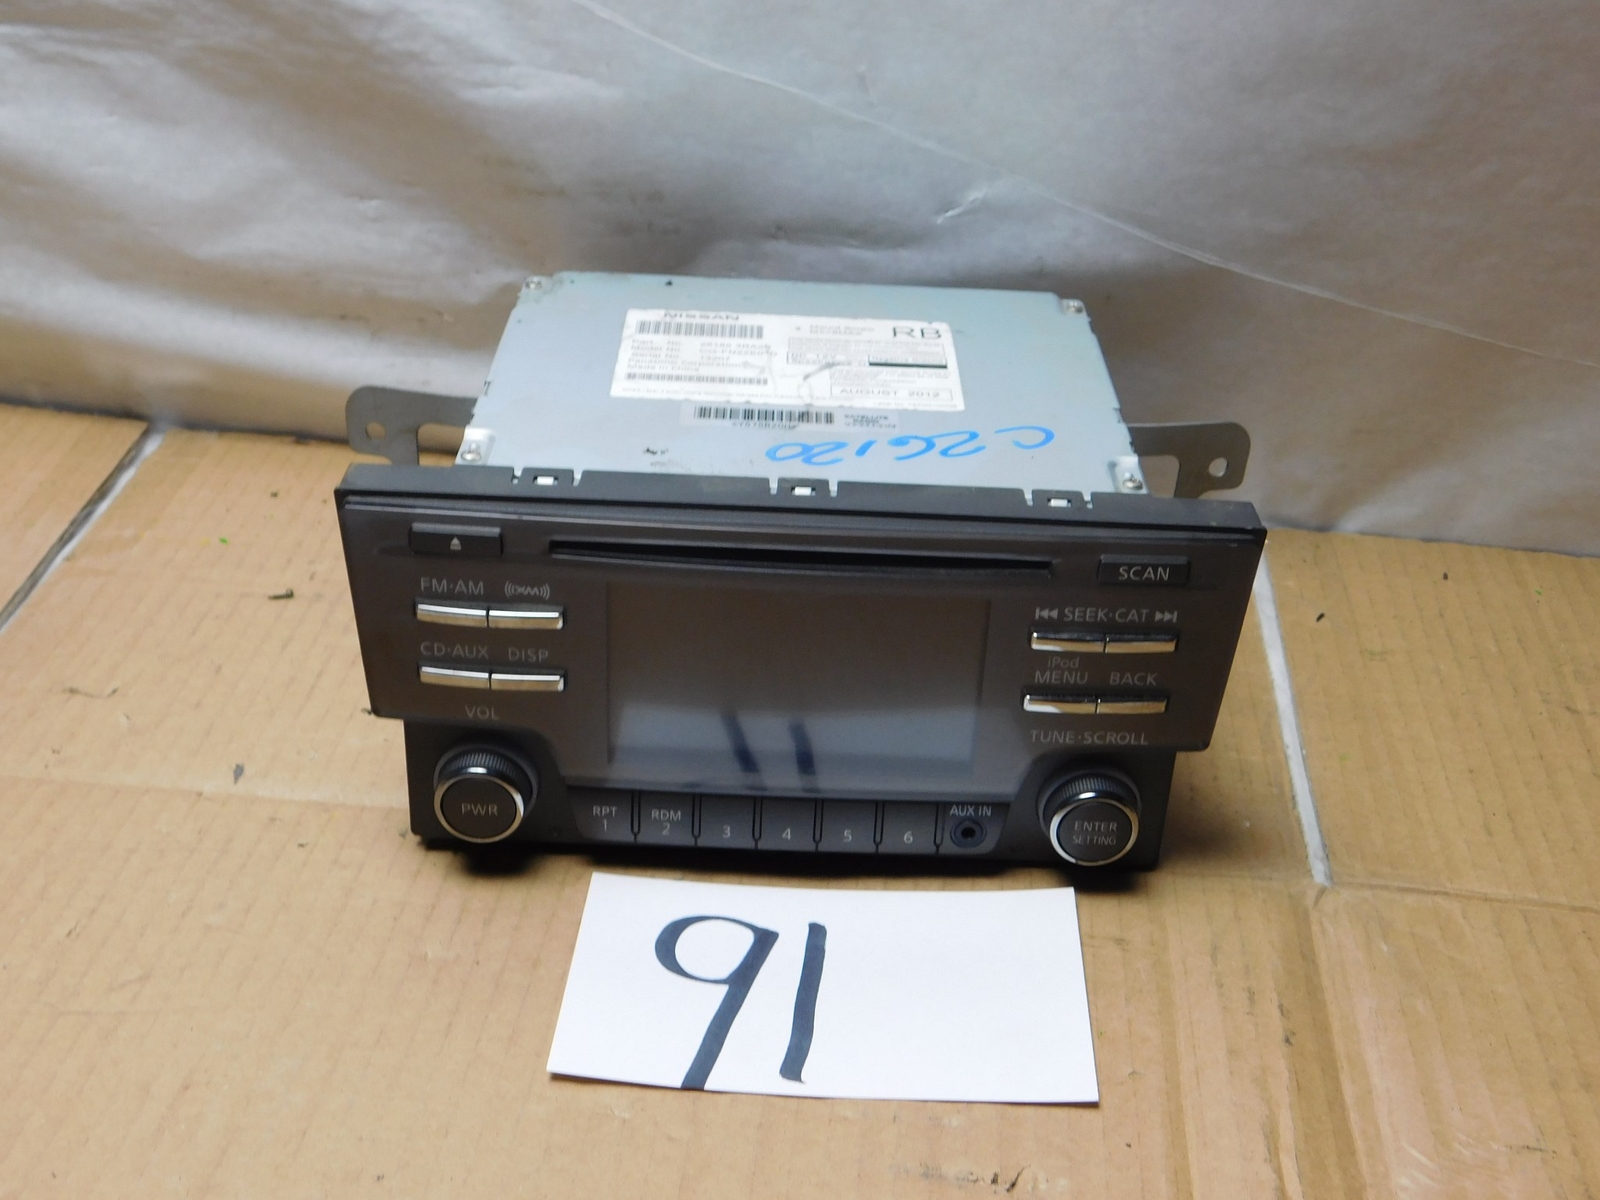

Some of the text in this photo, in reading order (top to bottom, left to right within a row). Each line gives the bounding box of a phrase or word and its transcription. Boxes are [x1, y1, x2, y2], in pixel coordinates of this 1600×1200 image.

[664, 312, 739, 321] NISSAN
[892, 325, 942, 340] RB
[839, 387, 898, 396] AUGUST
[908, 390, 941, 398] 2012
[1118, 565, 1171, 581] SCAN
[507, 647, 549, 662] DISP
[1047, 656, 1080, 669] iPod
[1034, 670, 1159, 686] MENU BACK
[465, 704, 499, 720] VOL
[461, 802, 499, 817] PWR
[592, 804, 992, 821] RPT RDM AUX IN
[602, 819, 913, 844] 1 2 3 4 5 6
[1072, 821, 1118, 845] ENTER SETTING
[655, 914, 828, 1091] 91
